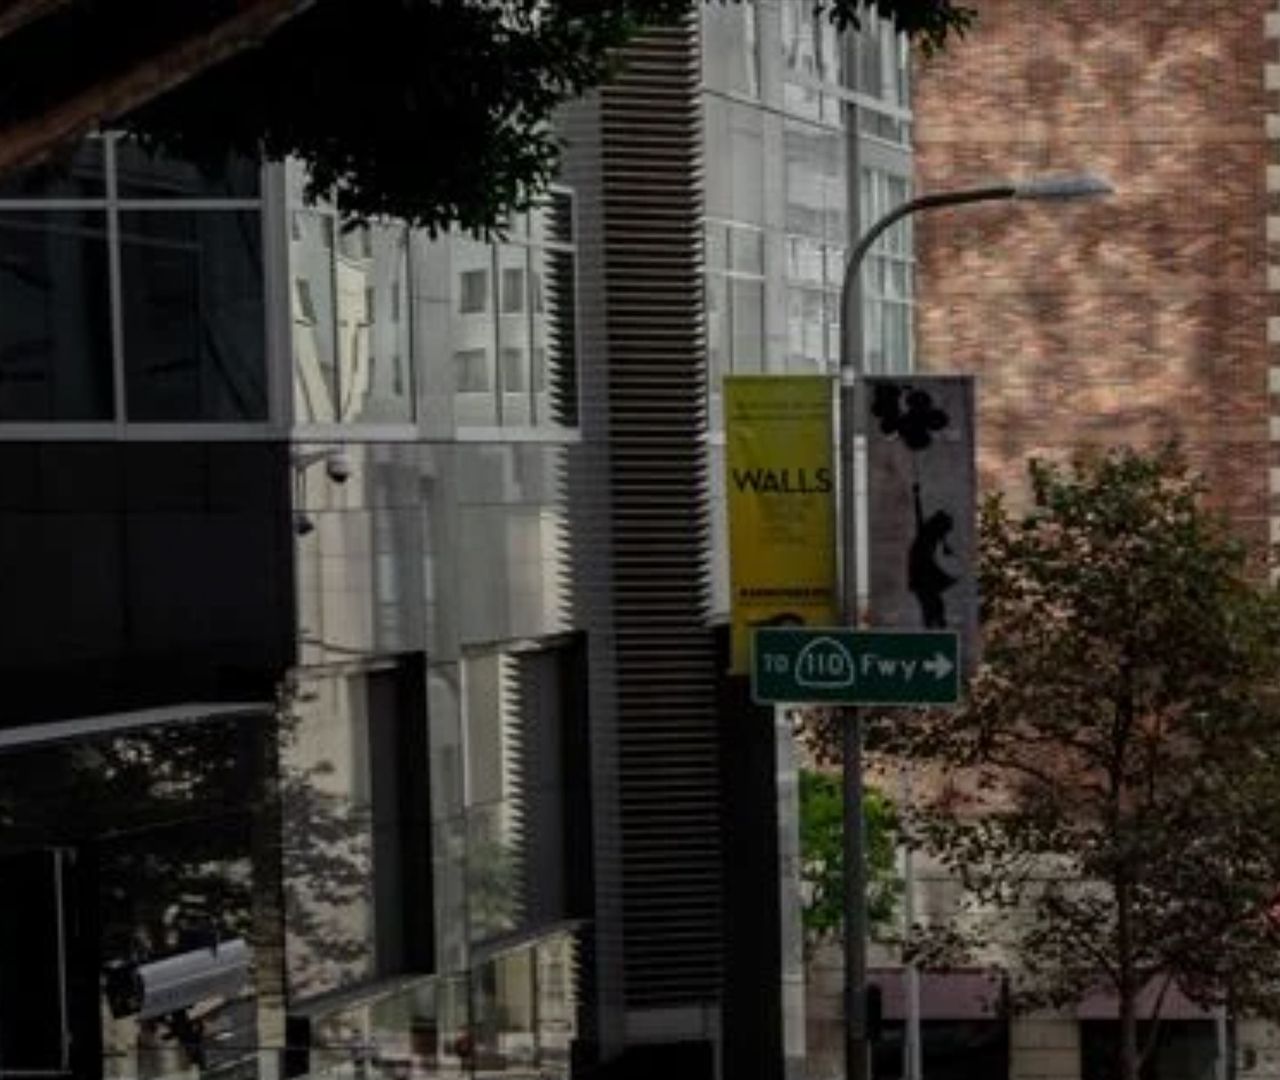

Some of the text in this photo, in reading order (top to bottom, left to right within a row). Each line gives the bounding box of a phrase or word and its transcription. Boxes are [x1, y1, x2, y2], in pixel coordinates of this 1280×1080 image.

[733, 468, 832, 494] WALLS
[763, 653, 917, 681] TO 110 Fwy
